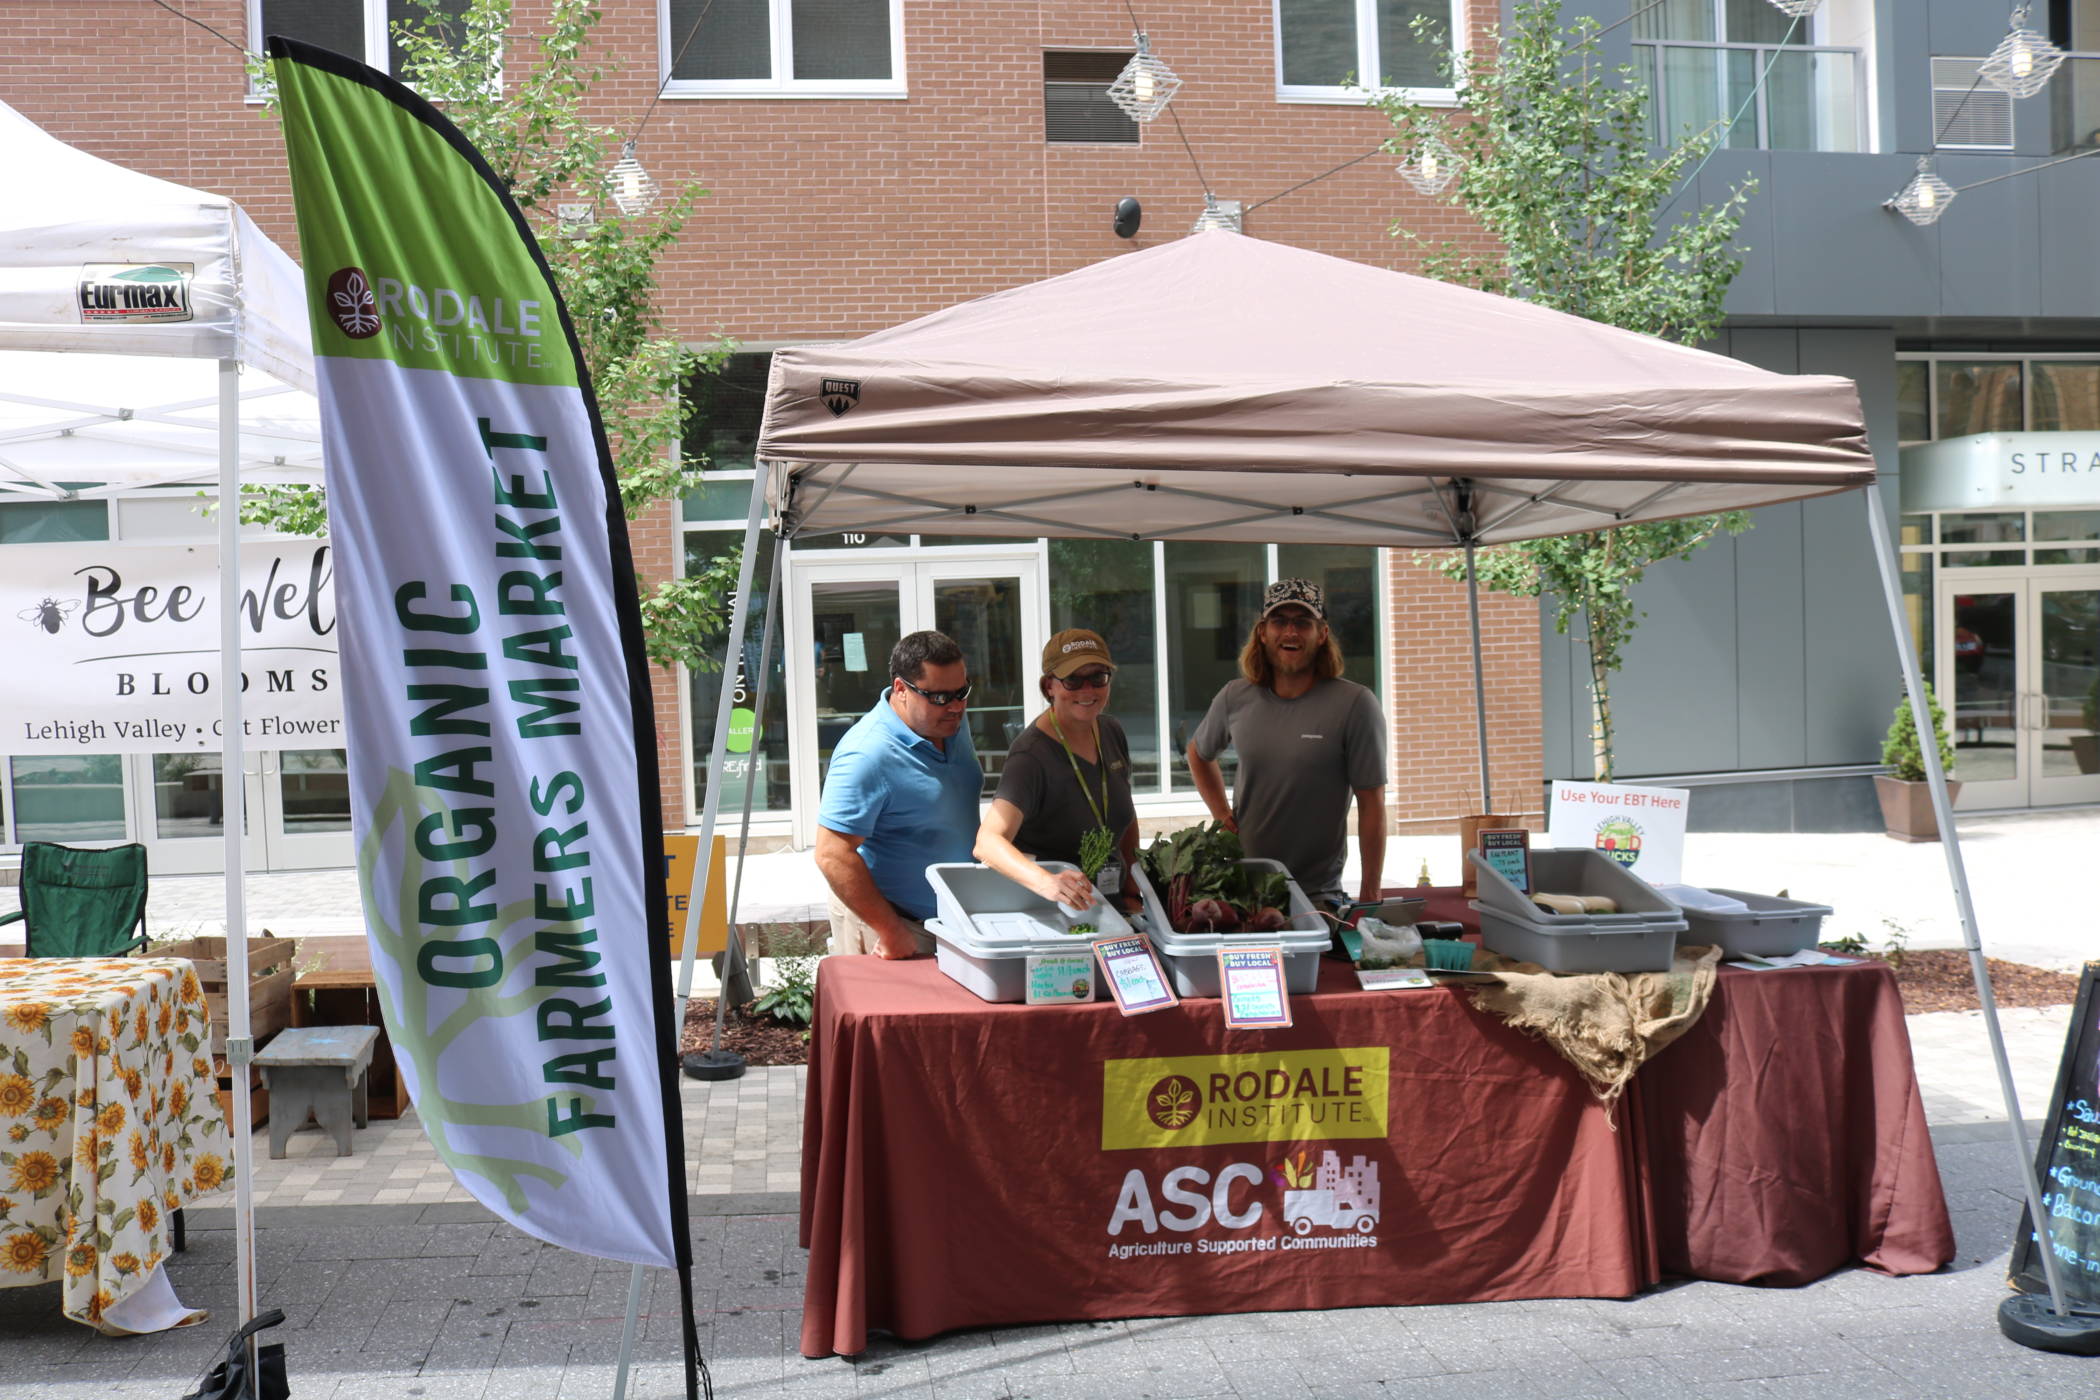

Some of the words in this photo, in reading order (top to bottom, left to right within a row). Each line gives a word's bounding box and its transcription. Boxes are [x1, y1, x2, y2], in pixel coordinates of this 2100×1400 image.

[81, 280, 180, 309] Eurmax
[377, 277, 542, 337] RODALE
[825, 381, 856, 393] QUEST
[2011, 452, 2100, 474] STRA
[477, 417, 582, 739] MARKET
[73, 565, 206, 638] Bee
[25, 720, 105, 745] Lehigh
[114, 717, 187, 742] Valley
[212, 717, 252, 737] Ct
[260, 716, 341, 736] Flower
[728, 727, 754, 735] ALLER
[394, 581, 504, 989] ORGANIC
[1561, 789, 1586, 803] Use
[1590, 791, 1620, 805] Your
[1624, 793, 1648, 806] EBT
[1651, 795, 1680, 809] Here
[1606, 850, 1636, 862] UCKS
[530, 771, 617, 1139] FARMERS
[1103, 943, 1120, 951] BUY
[1120, 939, 1141, 948] FRESH
[1106, 950, 1121, 958] BUY
[1121, 946, 1144, 955] LOCAL
[1246, 952, 1271, 960] FRESH
[1208, 1066, 1363, 1104] RODALE
[1208, 1102, 1363, 1129] INSTITUTE
[1107, 1163, 1264, 1236] ASC
[1108, 1241, 1192, 1260] Agriculture
[1196, 1236, 1276, 1256] Supported
[1280, 1233, 1378, 1251] Communities
